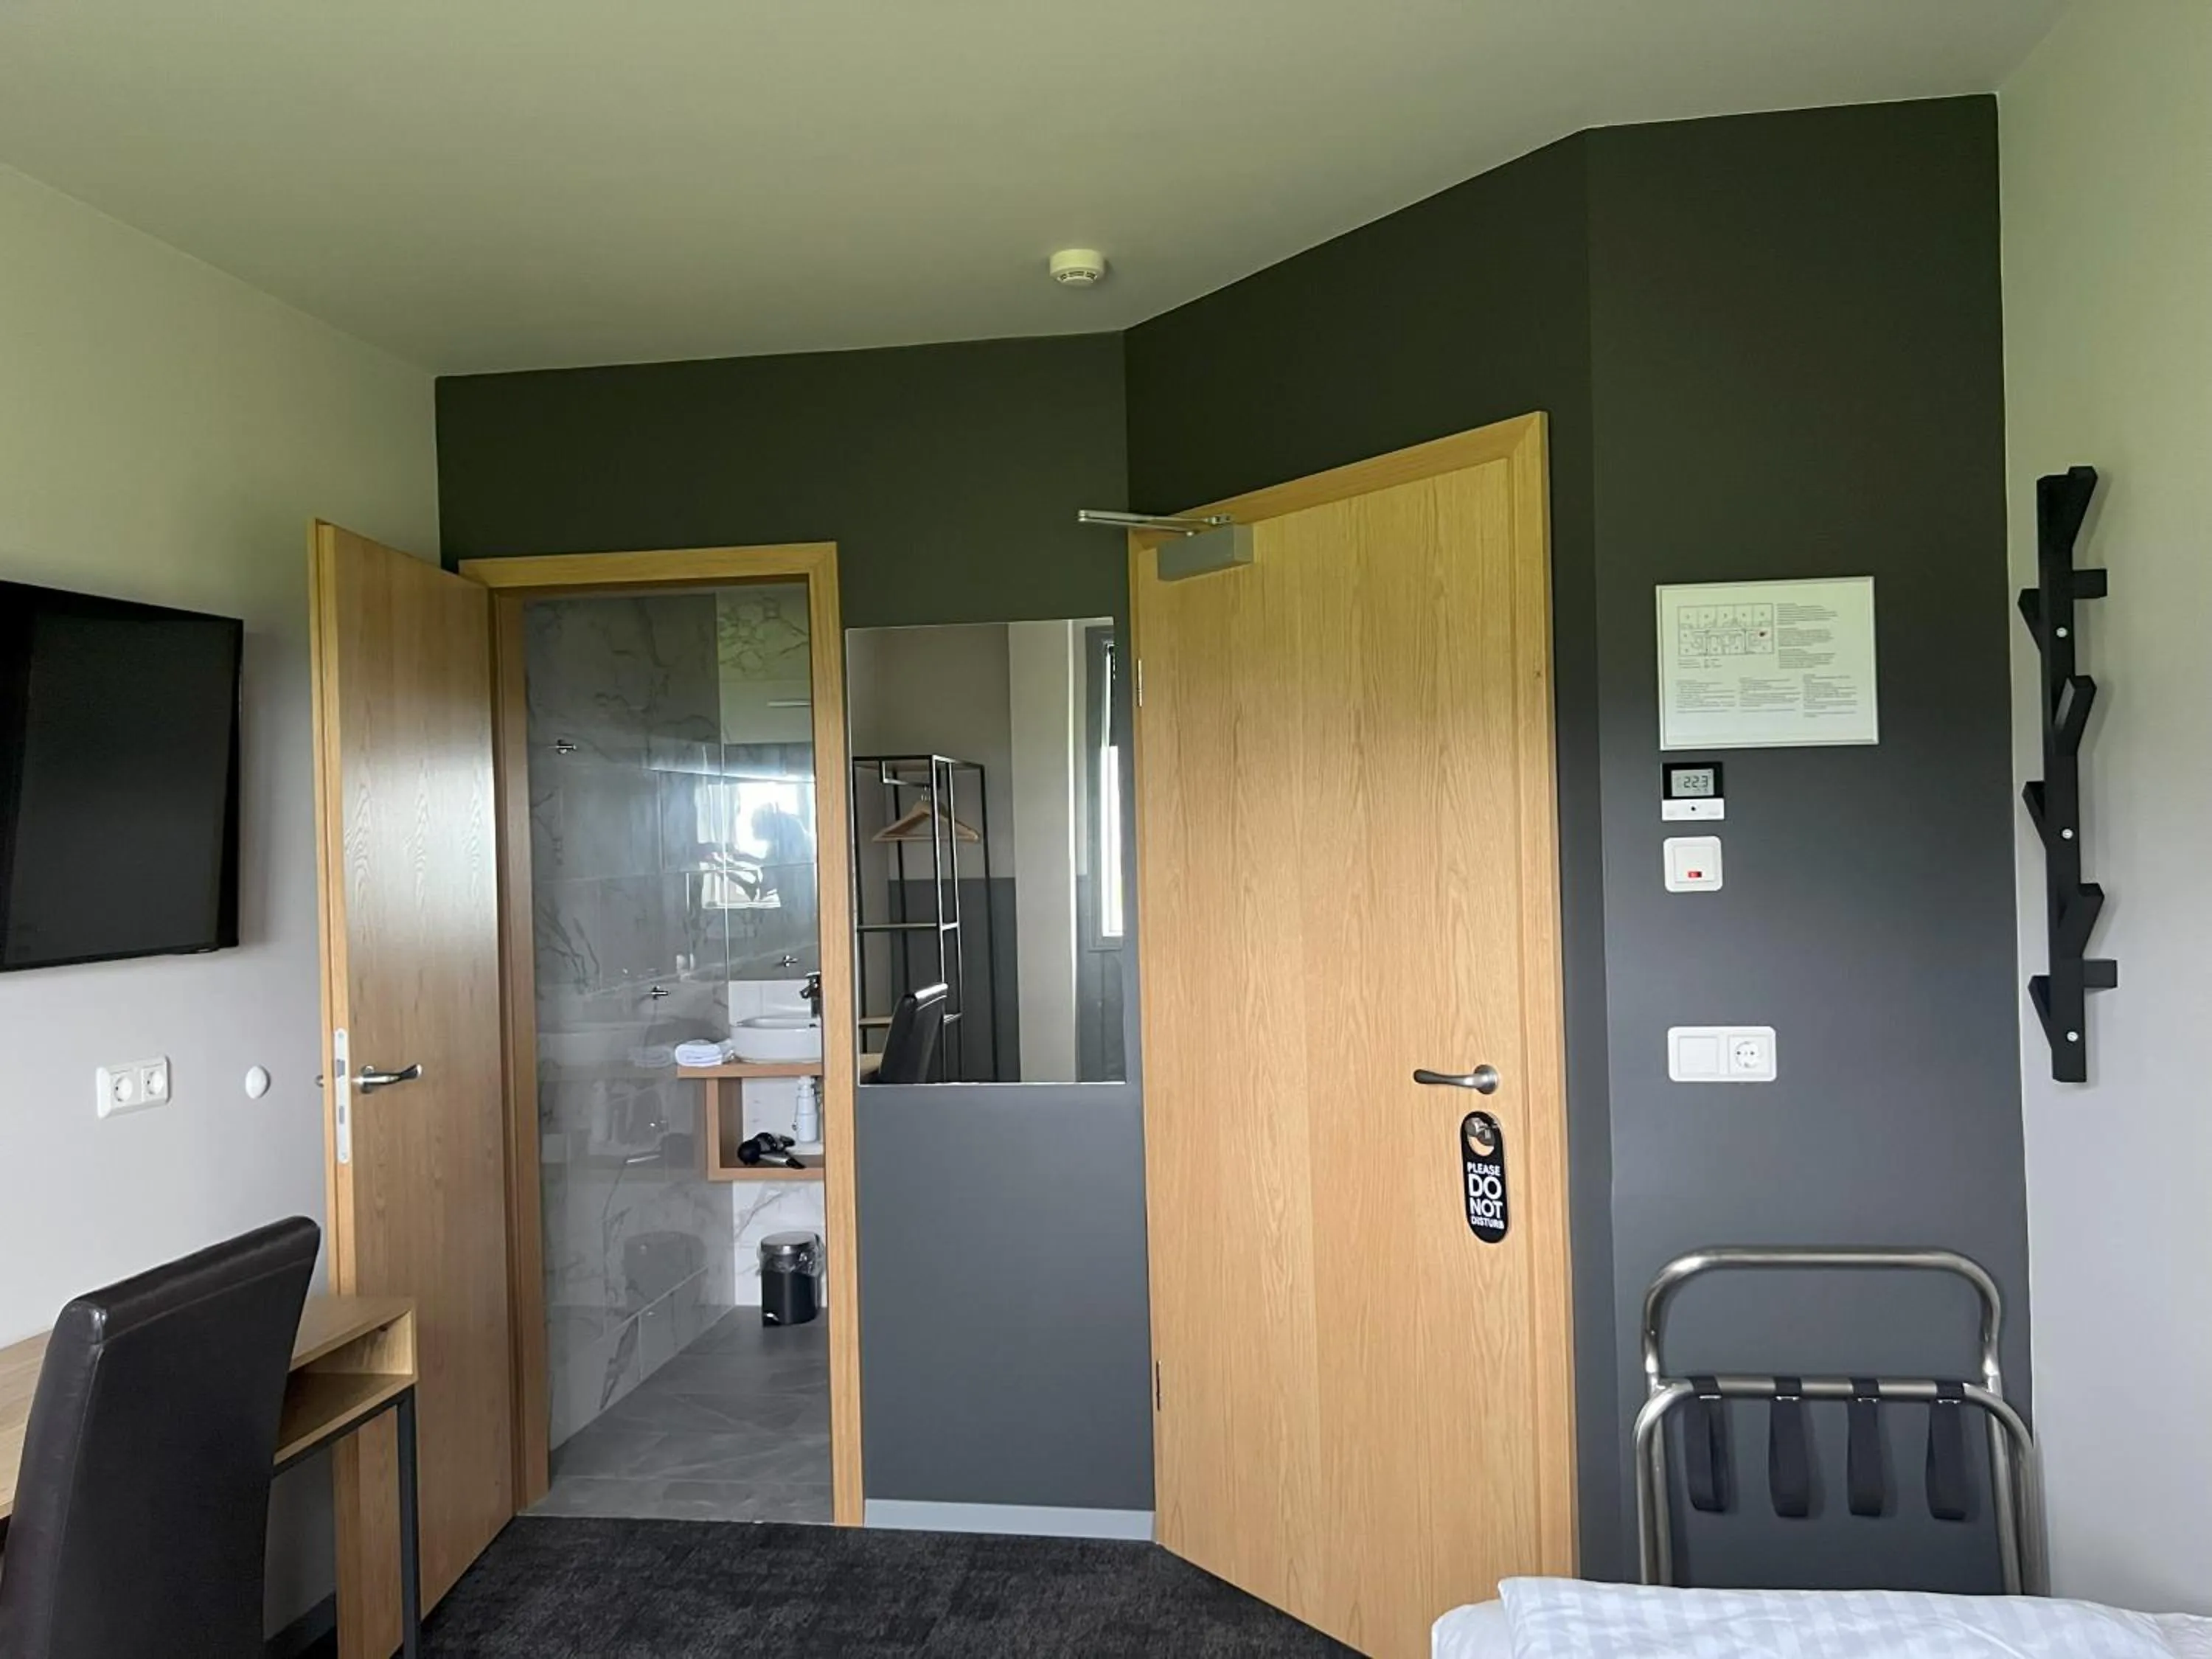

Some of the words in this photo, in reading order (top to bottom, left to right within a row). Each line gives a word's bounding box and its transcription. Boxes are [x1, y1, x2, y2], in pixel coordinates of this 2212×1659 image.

[1467, 1162, 1500, 1176] PLEASE
[1469, 1174, 1501, 1199] DO
[1470, 1197, 1503, 1218] NOT
[1472, 1216, 1504, 1229] DISTURB
